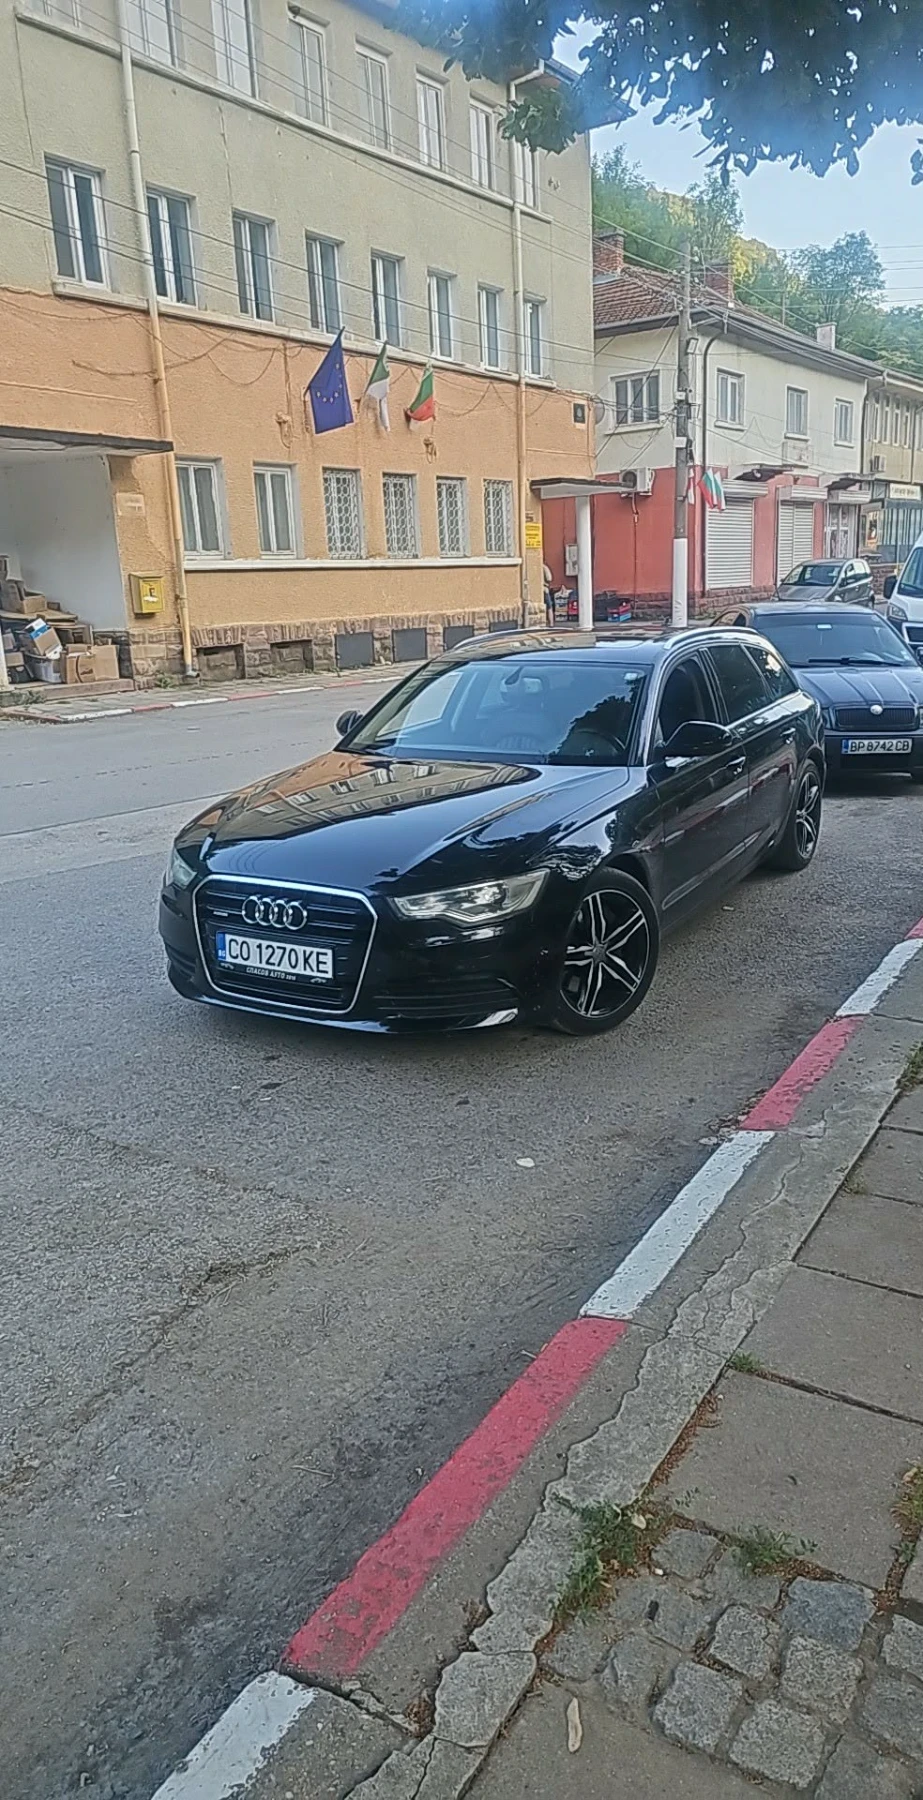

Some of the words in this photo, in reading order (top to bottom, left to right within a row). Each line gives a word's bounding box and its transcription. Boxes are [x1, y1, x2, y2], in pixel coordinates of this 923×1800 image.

[850, 741, 865, 752] BP
[866, 741, 894, 752] 8742
[895, 740, 910, 752] CB
[228, 939, 250, 962] CO
[256, 943, 298, 969] 1270
[303, 950, 329, 974] KE
